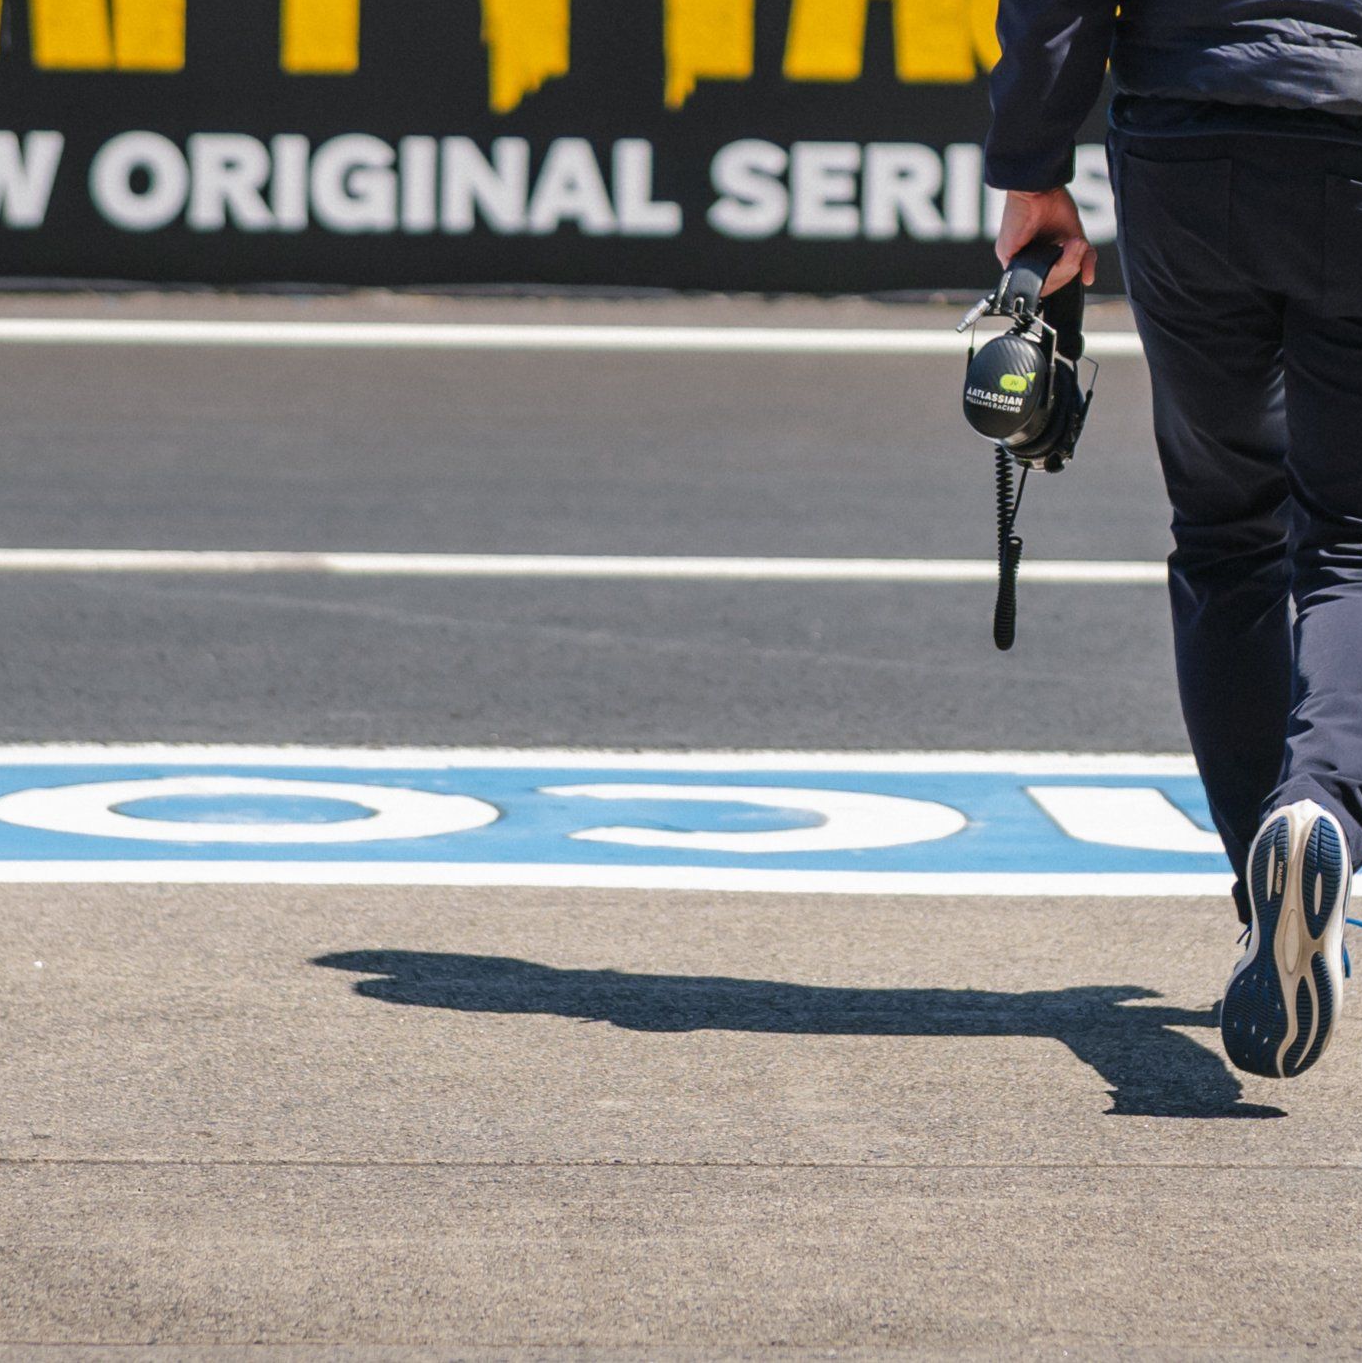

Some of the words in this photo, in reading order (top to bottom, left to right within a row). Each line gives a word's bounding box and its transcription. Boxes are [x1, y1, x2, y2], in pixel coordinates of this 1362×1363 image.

[88, 131, 683, 237] ORIGINAL
[706, 138, 1118, 242] SERIS
[971, 388, 1023, 406] ATLASSIAN
